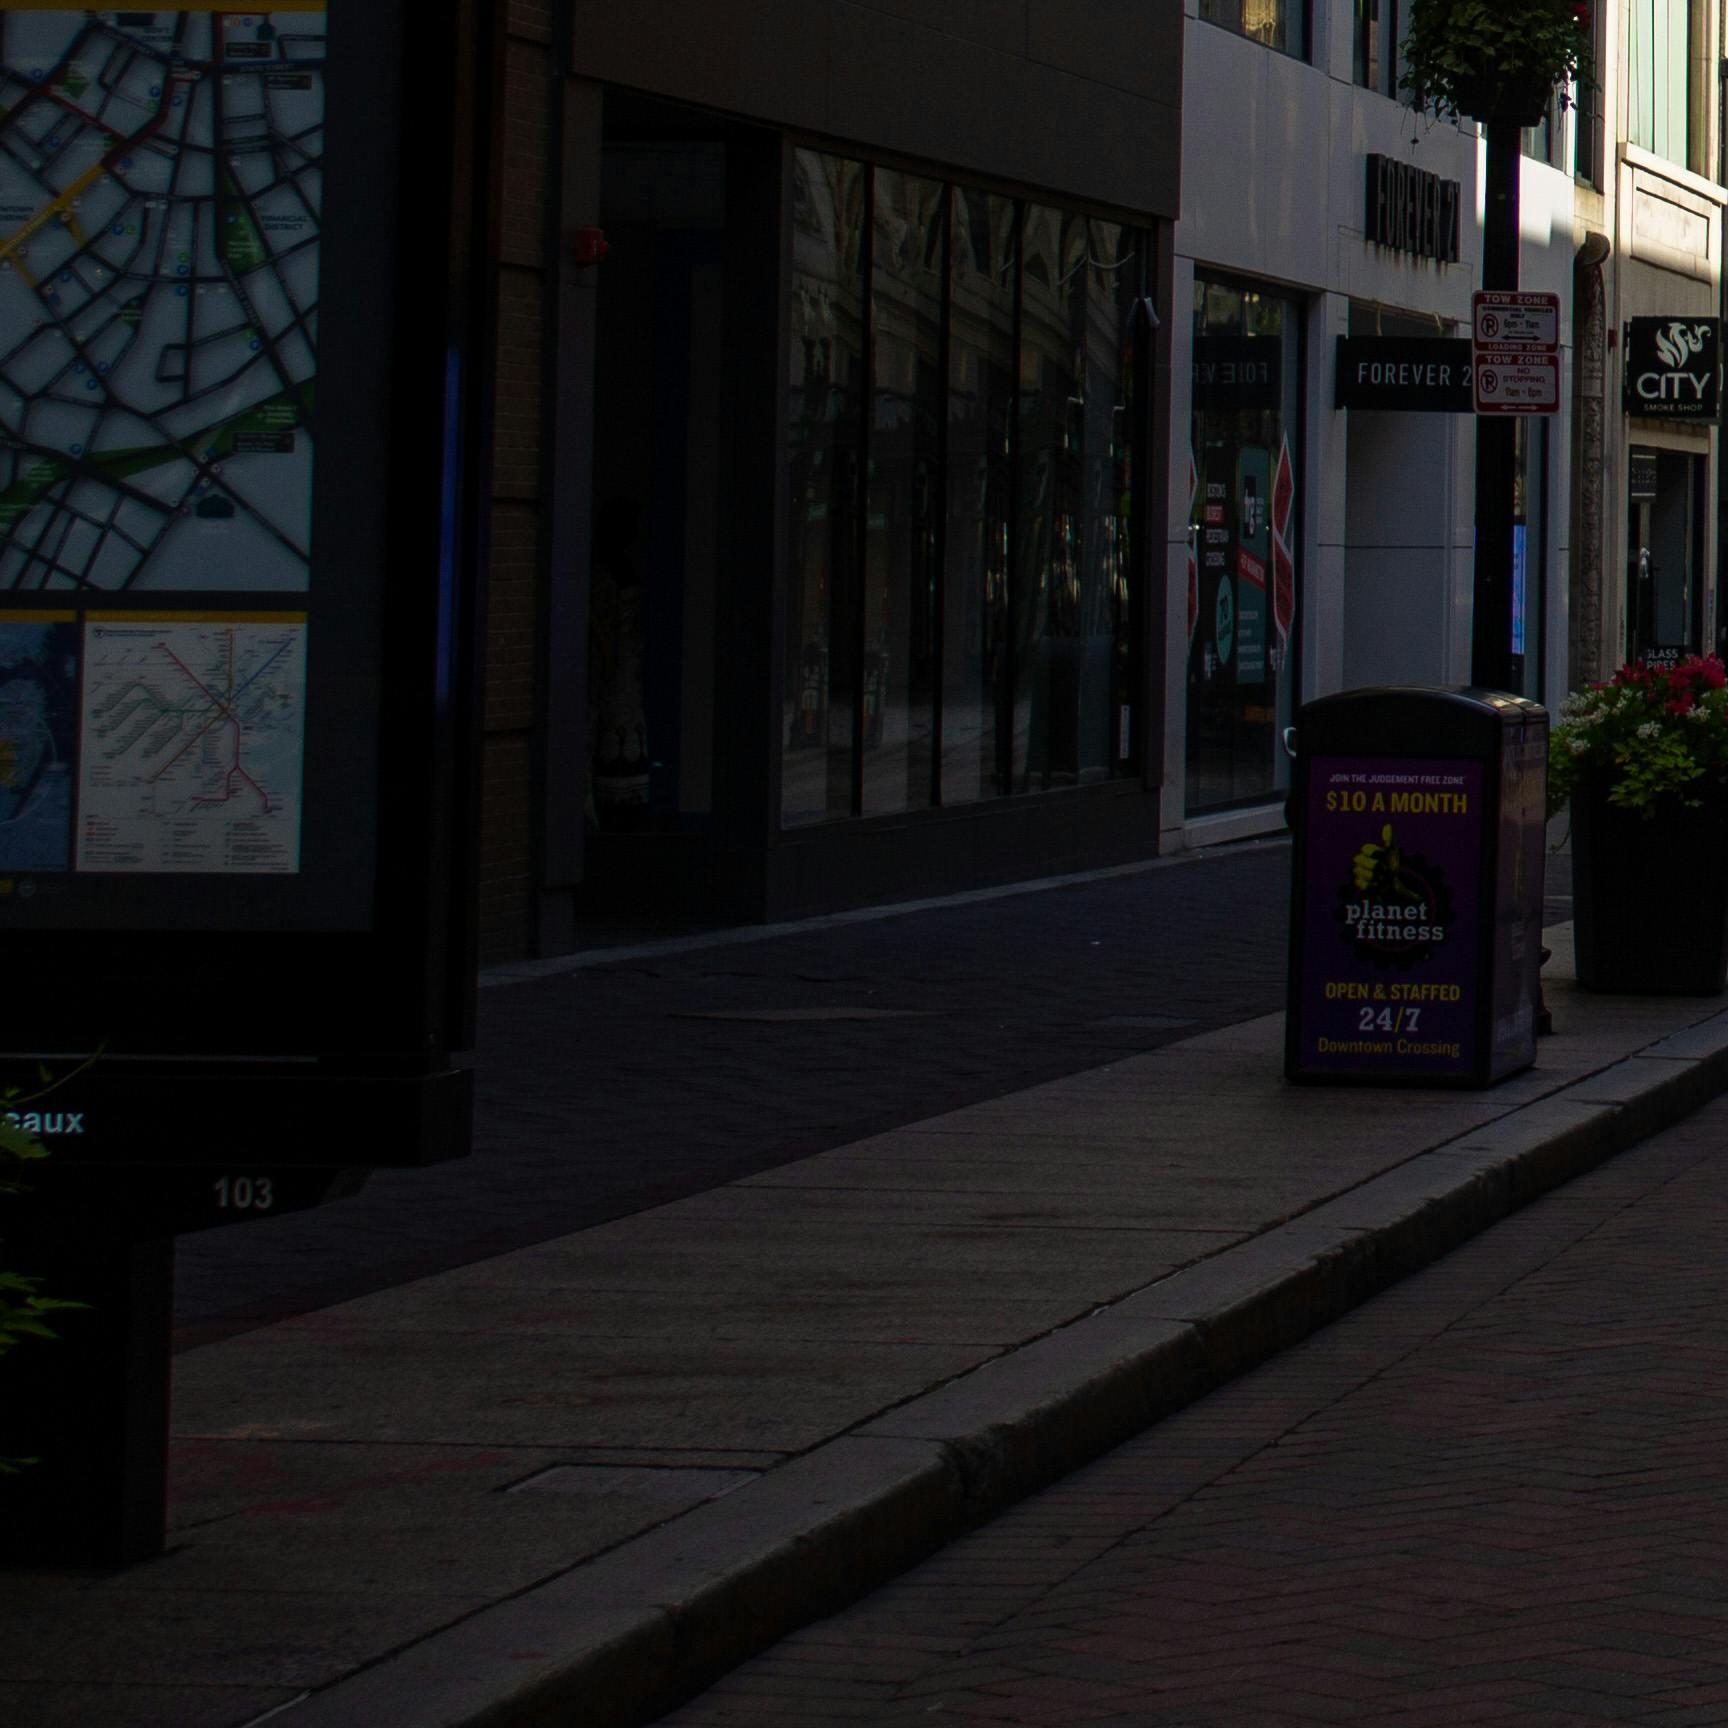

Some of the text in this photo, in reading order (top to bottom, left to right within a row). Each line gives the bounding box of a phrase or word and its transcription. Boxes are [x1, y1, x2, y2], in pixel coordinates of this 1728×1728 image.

[1366, 154, 1441, 259] FOREVER
[1484, 294, 1549, 305] TOW ZONE
[1488, 343, 1523, 351] LOADING
[1484, 355, 1550, 365] TOW ZONE
[1357, 361, 1451, 387] FOREVER
[1502, 375, 1546, 384] STOPPING
[1517, 367, 1530, 375] NO
[1636, 371, 1712, 400] CITY
[1643, 402, 1704, 413] SMOKE SHOP
[1328, 774, 1464, 785] JOIN THE JUDGEMENT FREE ZONE
[1326, 791, 1468, 816] $10 A MONTH
[1345, 899, 1429, 926] planet
[1355, 919, 1445, 942] fitness
[1324, 982, 1462, 1002] OPEN & STAFFED
[1358, 1007, 1422, 1033] 24/7
[1317, 1038, 1461, 1058] Downtown Crossing
[211, 1174, 274, 1210] 103
